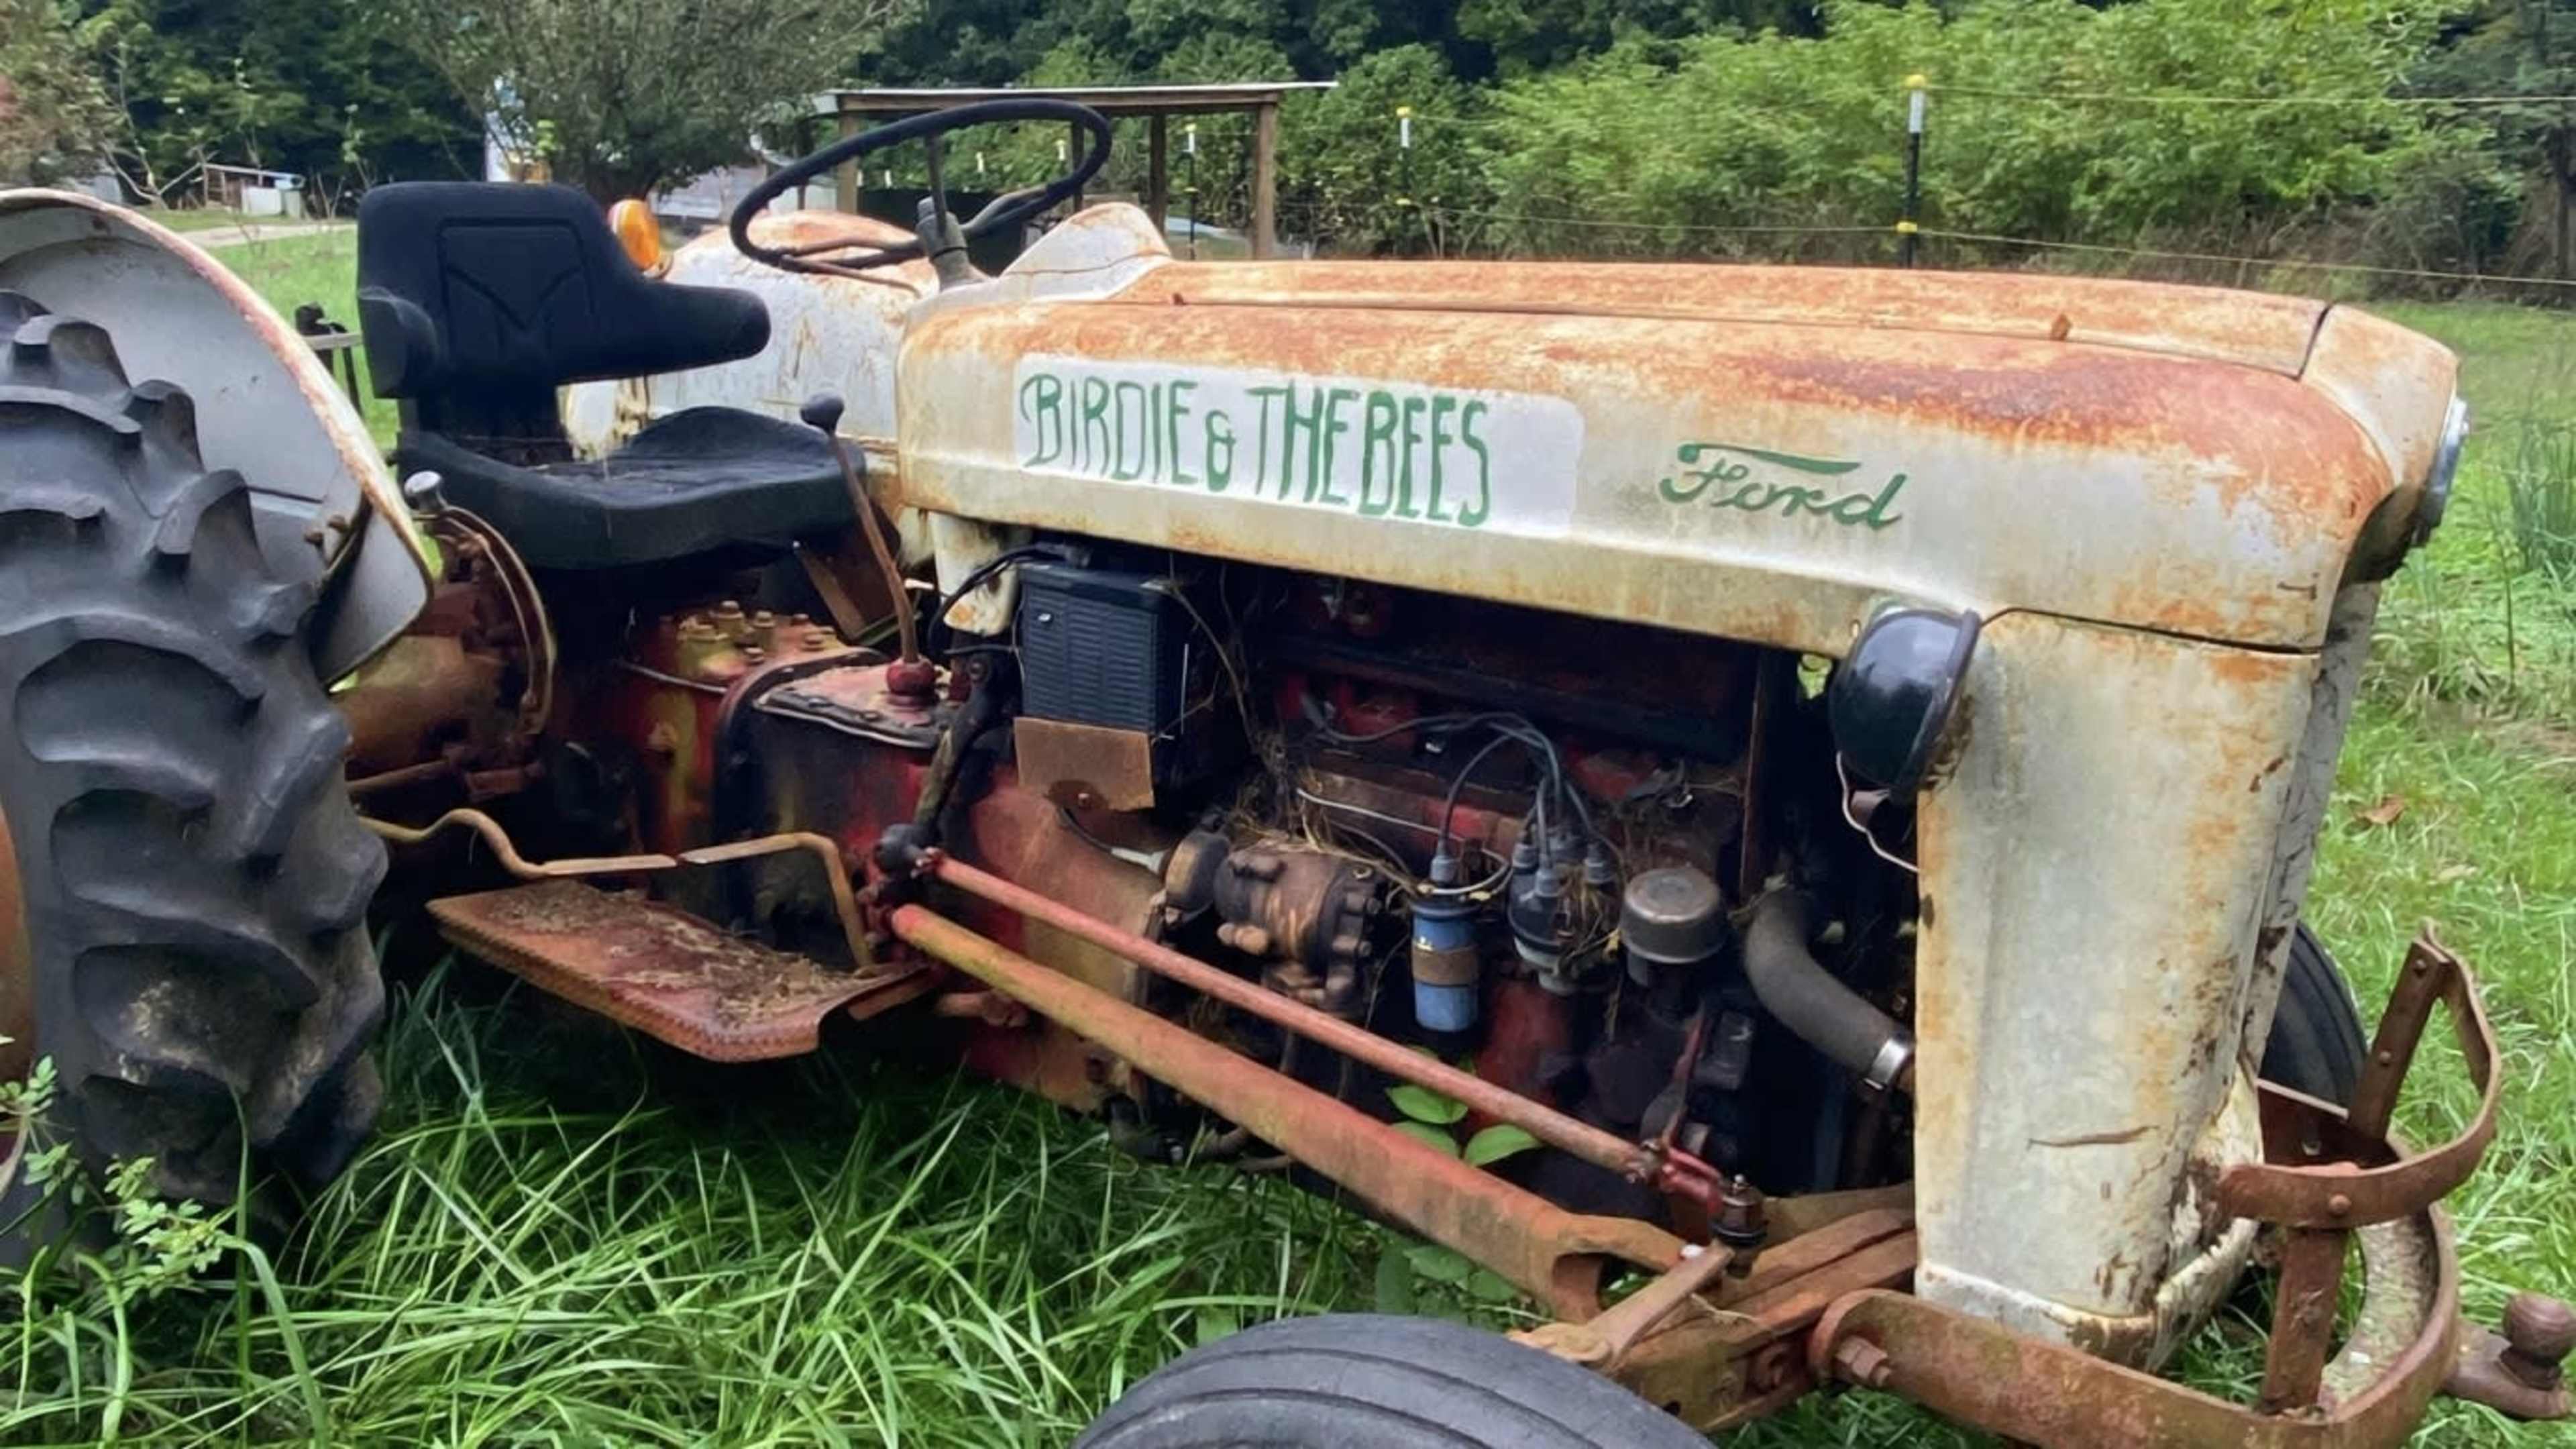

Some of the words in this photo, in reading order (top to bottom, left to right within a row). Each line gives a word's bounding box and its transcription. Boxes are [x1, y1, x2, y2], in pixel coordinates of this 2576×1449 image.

[1020, 374, 1199, 484] BIRDIE
[1205, 411, 1236, 492] &
[1246, 379, 1359, 505] THE
[1359, 390, 1490, 527] BEES
[1659, 443, 1907, 529] Ford
